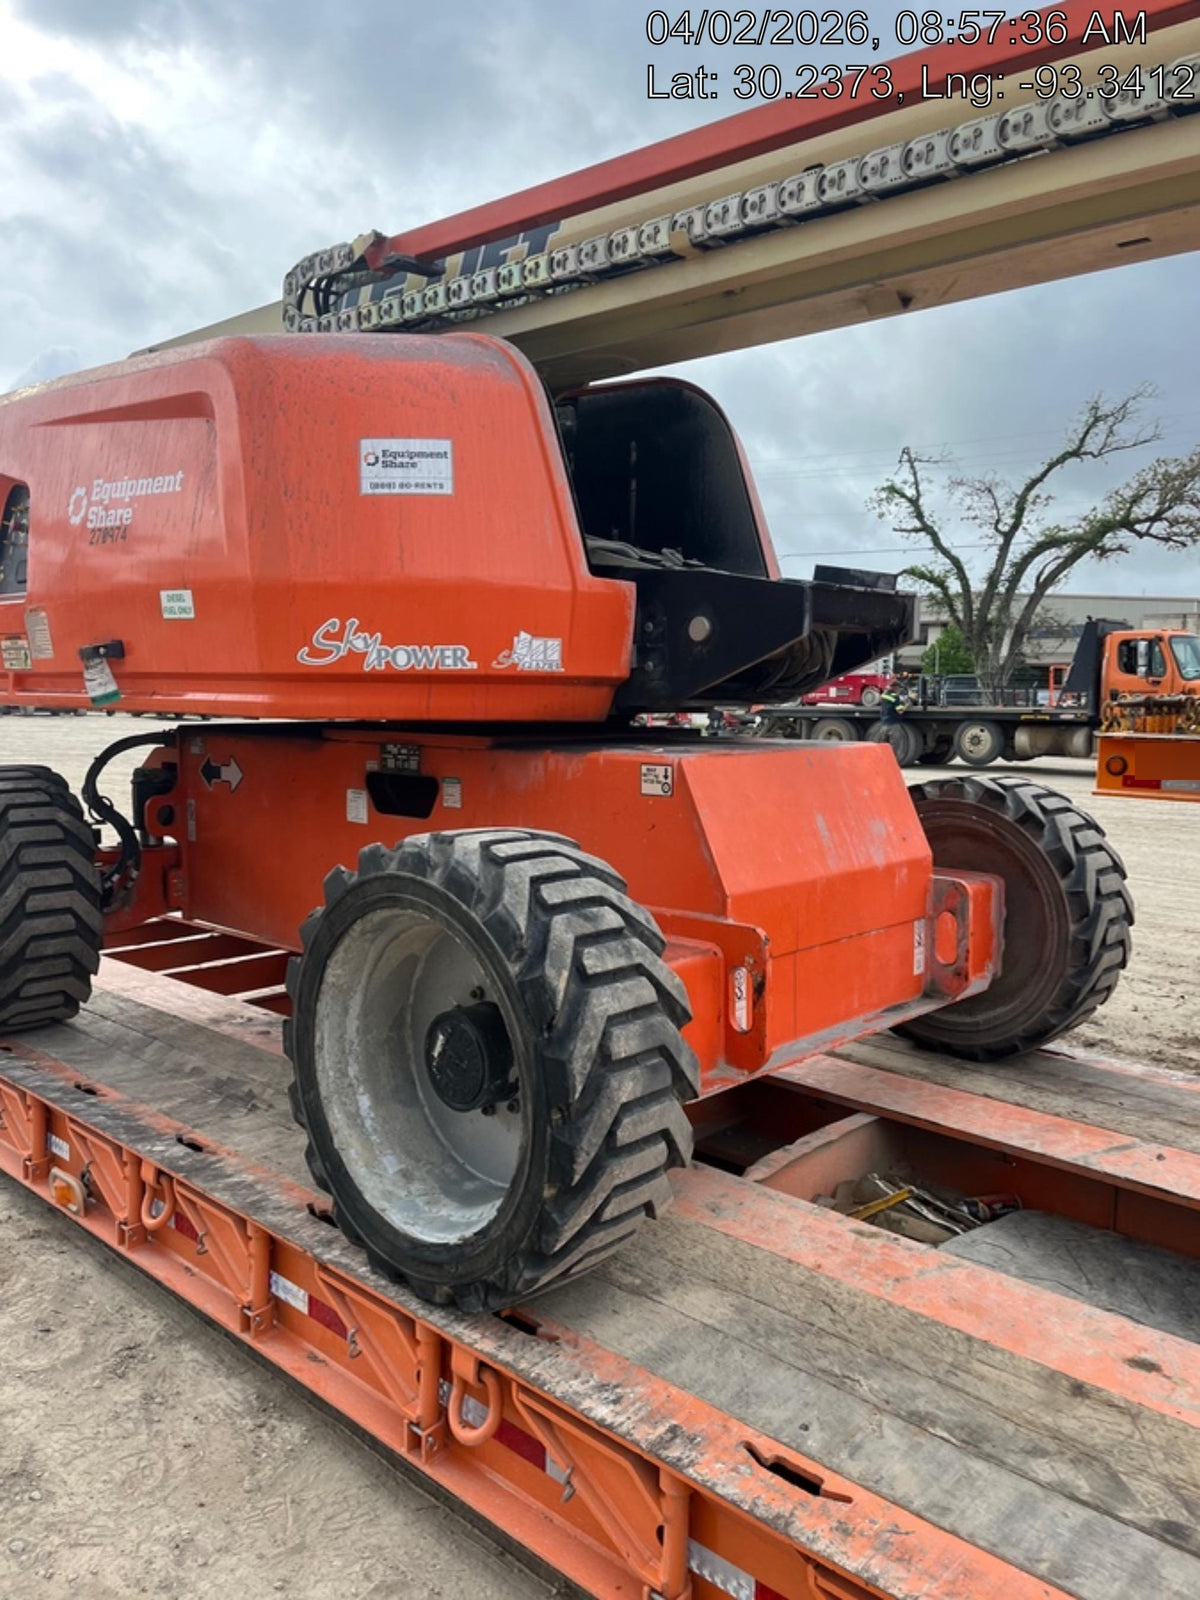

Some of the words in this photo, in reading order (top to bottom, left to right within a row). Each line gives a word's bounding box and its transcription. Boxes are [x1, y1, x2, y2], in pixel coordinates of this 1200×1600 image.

[381, 449, 448, 460] Equipment
[381, 461, 418, 469] Share
[91, 470, 184, 503] Equipment
[87, 506, 132, 528] Share
